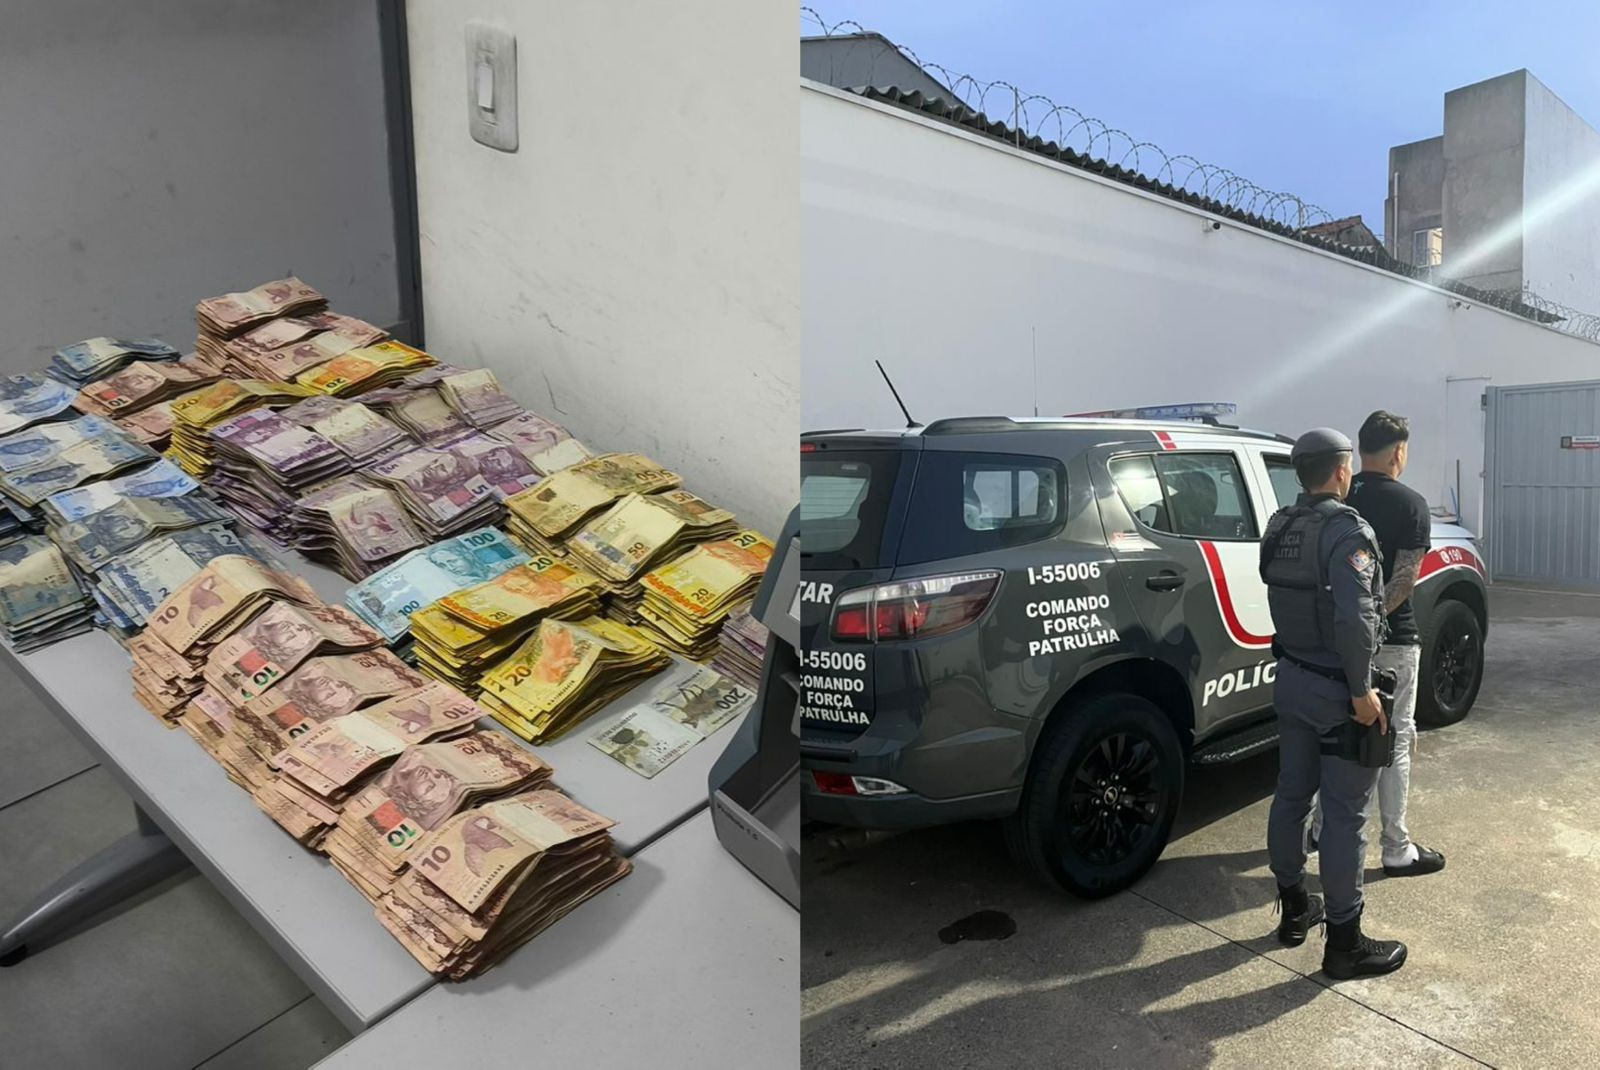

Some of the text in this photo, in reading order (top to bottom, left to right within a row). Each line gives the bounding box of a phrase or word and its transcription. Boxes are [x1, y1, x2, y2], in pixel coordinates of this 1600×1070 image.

[269, 352, 286, 362] 10
[108, 398, 126, 407] 10
[178, 399, 199, 411] 20
[218, 424, 234, 433] 5
[636, 471, 657, 481] 50
[472, 484, 489, 495] 5
[671, 490, 695, 502] 50
[221, 533, 238, 546] 2
[464, 532, 496, 547] 100
[733, 533, 758, 548] 20
[627, 541, 645, 556] 50
[528, 556, 554, 571] 20
[1027, 562, 1101, 585] I-55006
[159, 586, 171, 598] 2
[691, 587, 710, 602] 20
[398, 600, 420, 617] 100
[1025, 594, 1110, 618] COMANDO
[156, 605, 180, 625] 10
[1043, 613, 1102, 635] FORÇA
[1028, 628, 1121, 657] PATRULHA
[800, 650, 867, 671] I-55006
[252, 665, 279, 687] 10
[505, 665, 532, 687] 20
[1202, 660, 1278, 707] POLÍC
[717, 687, 747, 711] 200
[806, 691, 853, 710] FORÇA
[461, 744, 482, 756] 10
[387, 823, 417, 848] 10
[421, 845, 452, 872] 10
